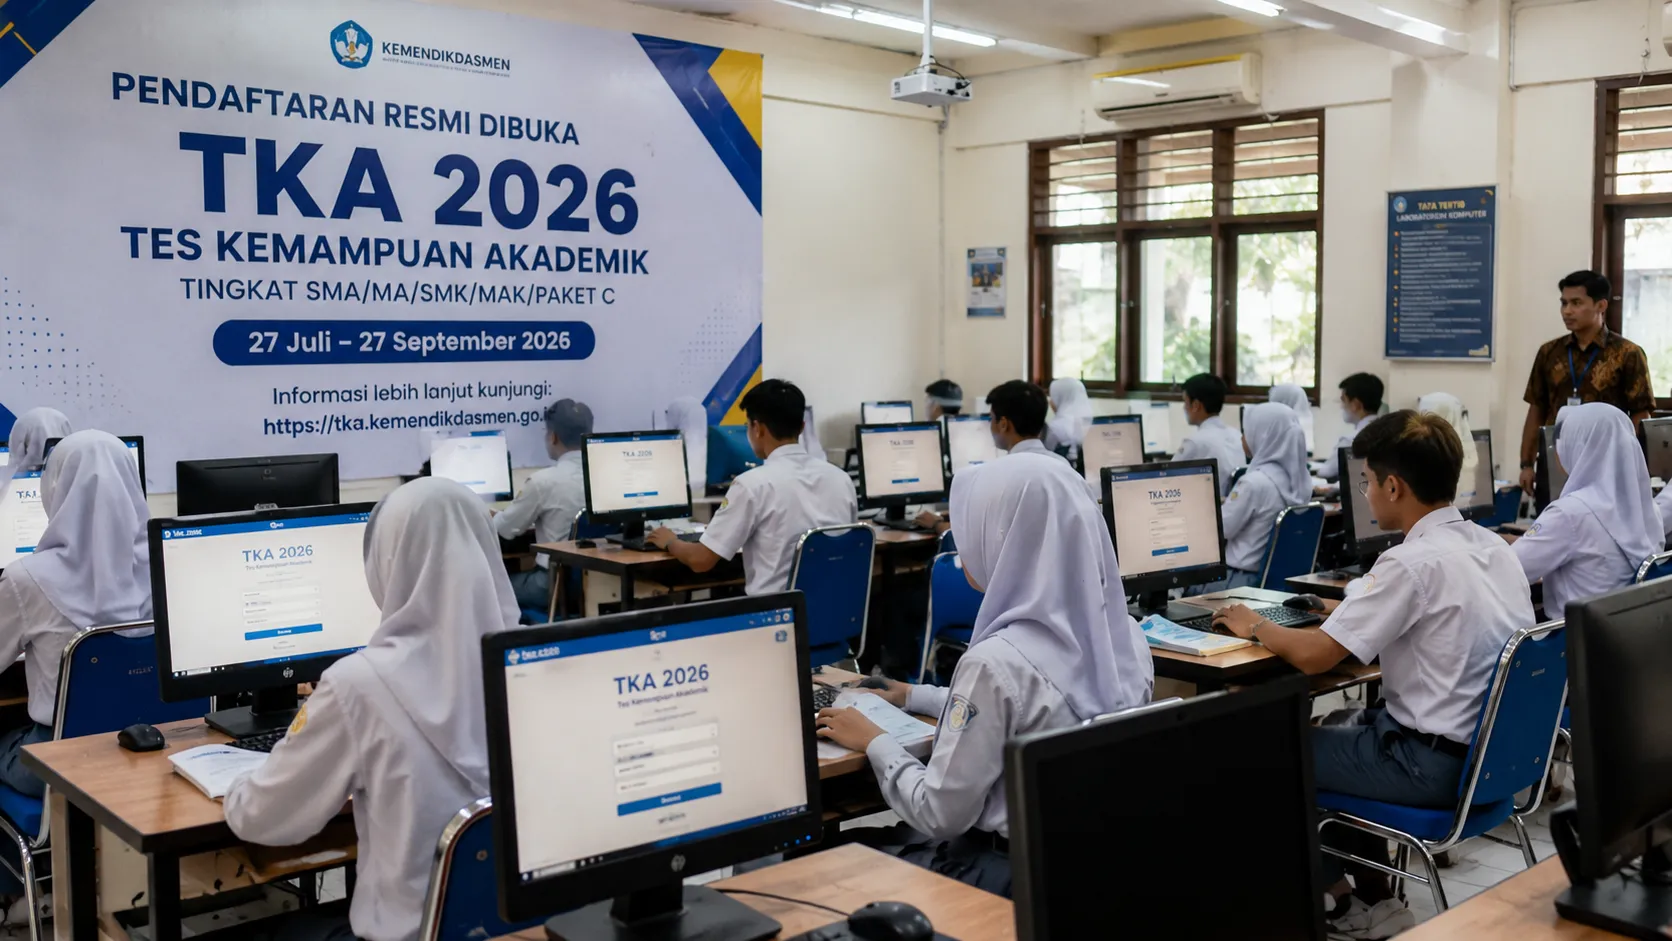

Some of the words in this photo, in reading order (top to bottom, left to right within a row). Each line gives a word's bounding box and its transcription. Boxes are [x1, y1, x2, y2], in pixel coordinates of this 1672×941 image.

[382, 41, 511, 71] KEMENDIKDASMEN
[112, 71, 374, 126] PENDAFTARAN
[384, 102, 471, 135] RESMI
[480, 114, 580, 146] DIBUKA
[179, 131, 404, 223] TKA
[433, 153, 639, 236] 2026
[121, 226, 202, 261] TES
[217, 231, 473, 269] KEMAMPUAN
[484, 242, 649, 275] AKADEMIK
[180, 278, 298, 300] TINGKAT
[306, 280, 597, 306] SMA/MA/SMK/MAK/PAKET
[602, 287, 615, 304] C
[248, 331, 279, 353] 27
[286, 330, 331, 353] Juli
[359, 331, 387, 352] 27
[392, 331, 517, 356] September
[521, 331, 571, 351] 2026
[273, 385, 368, 405] Informasi
[374, 383, 419, 402] lebih
[424, 382, 474, 404] lanjut
[478, 380, 553, 404] kunjungi:
[263, 406, 556, 438] https://tka.kemendikdasmen.go.i
[1148, 491, 1163, 499] TKA
[242, 549, 274, 562] TKA
[279, 544, 314, 559] 2026
[614, 673, 657, 695] TKA
[662, 663, 710, 687] 2026
